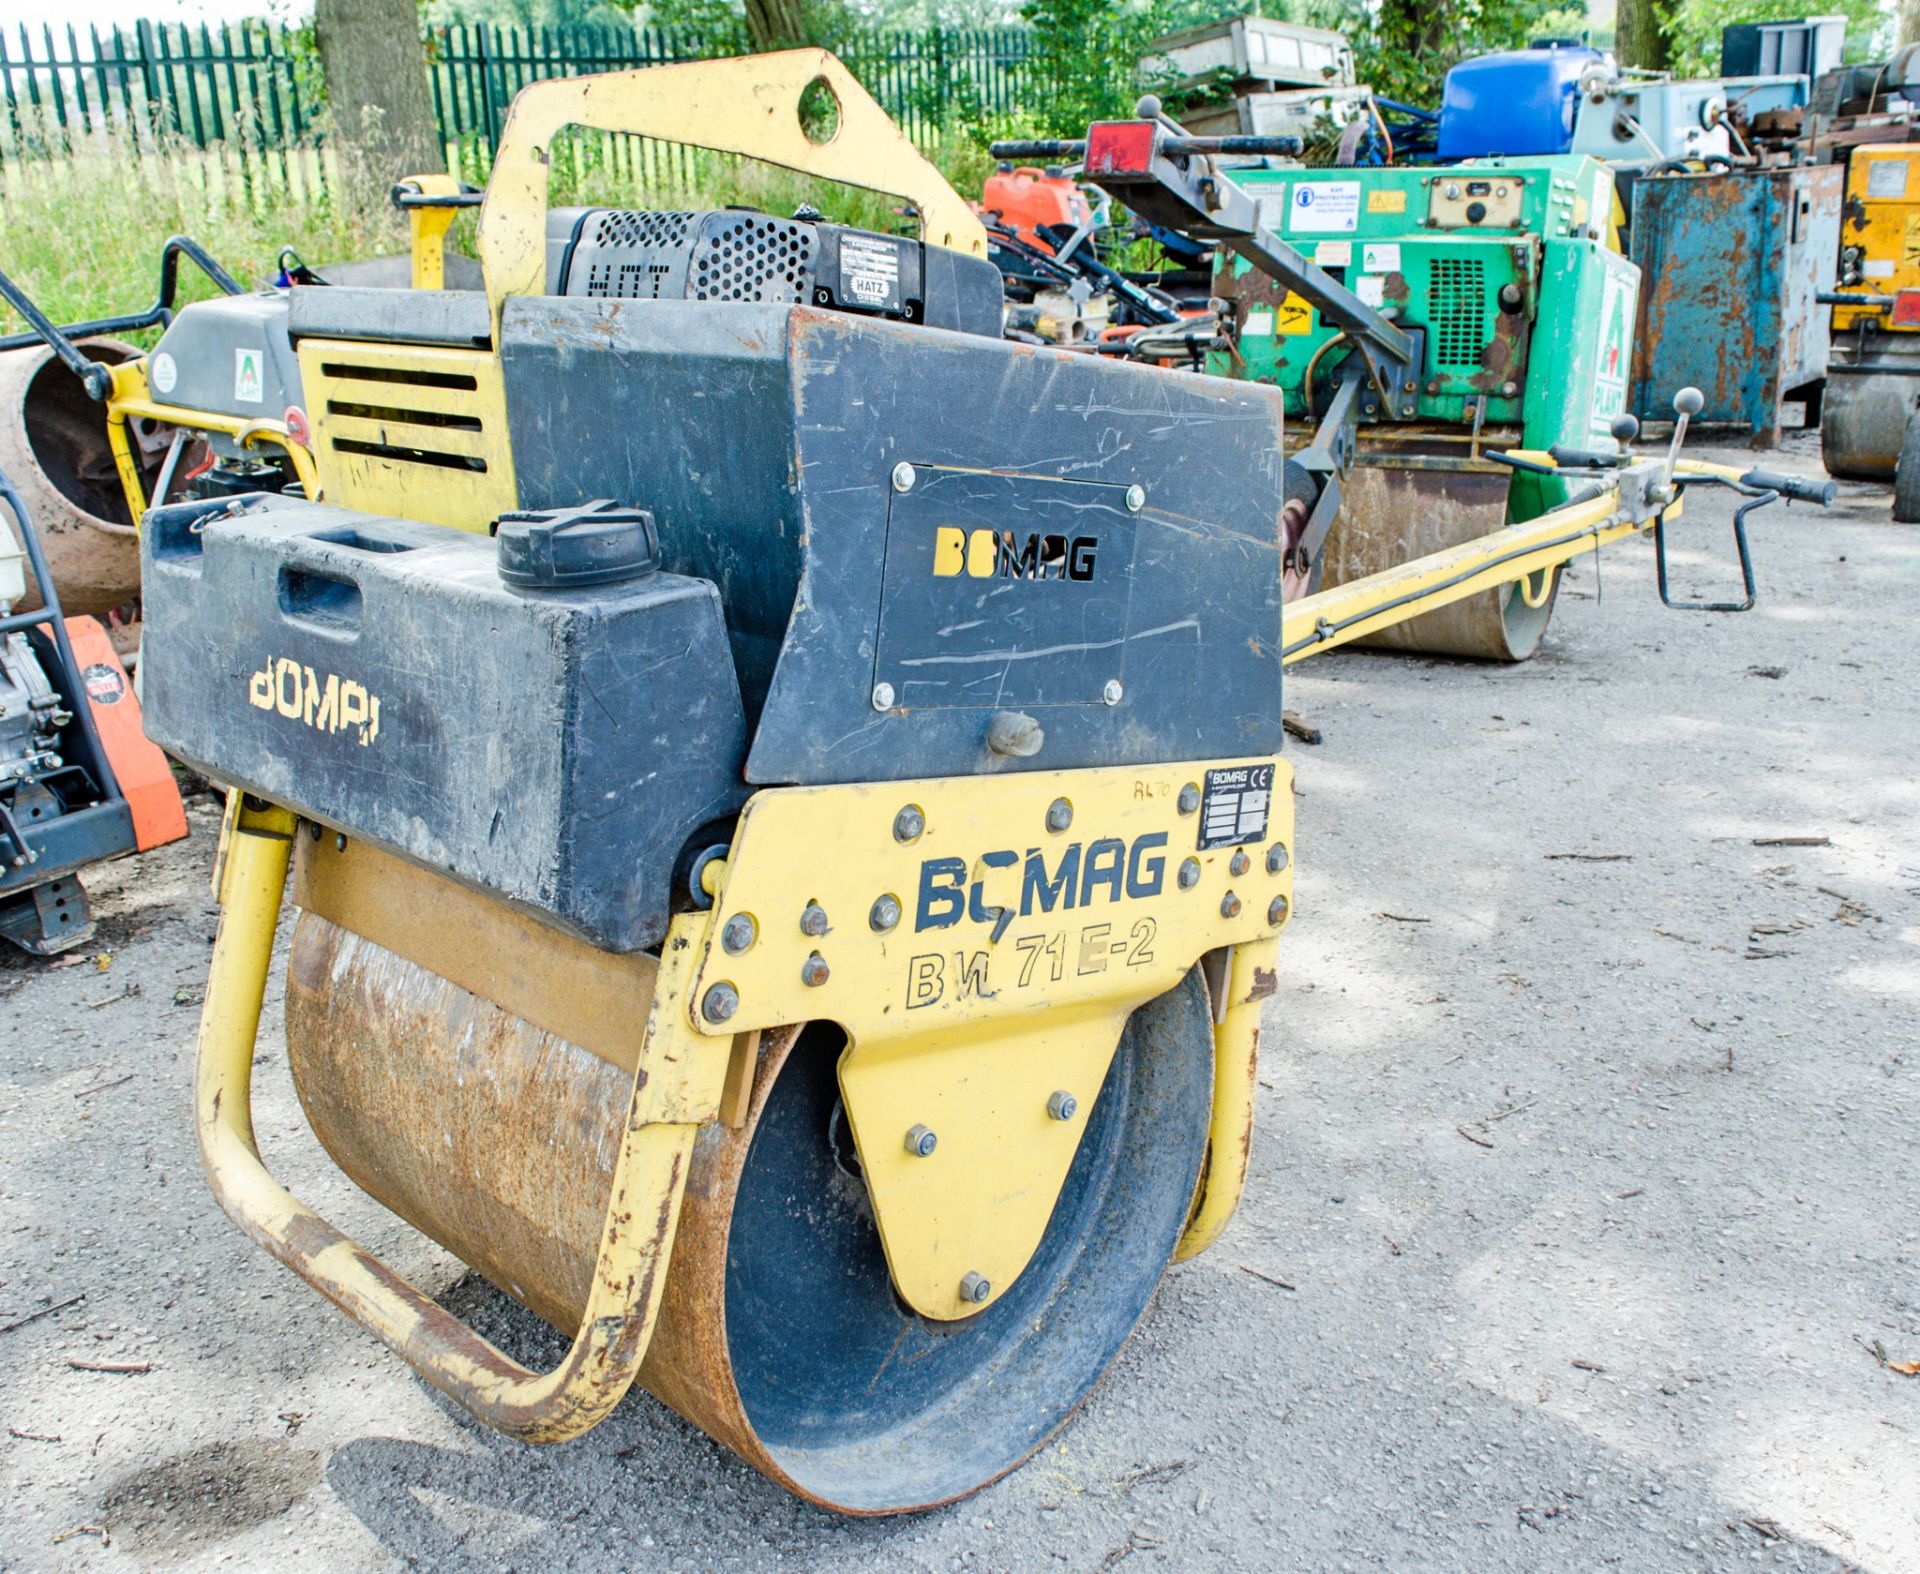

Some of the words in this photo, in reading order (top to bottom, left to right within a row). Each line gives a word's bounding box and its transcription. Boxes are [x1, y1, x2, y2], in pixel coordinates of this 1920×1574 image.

[856, 280, 884, 294] HATZ
[933, 526, 1099, 582] BOMAG
[1212, 770, 1248, 785] BOMAG
